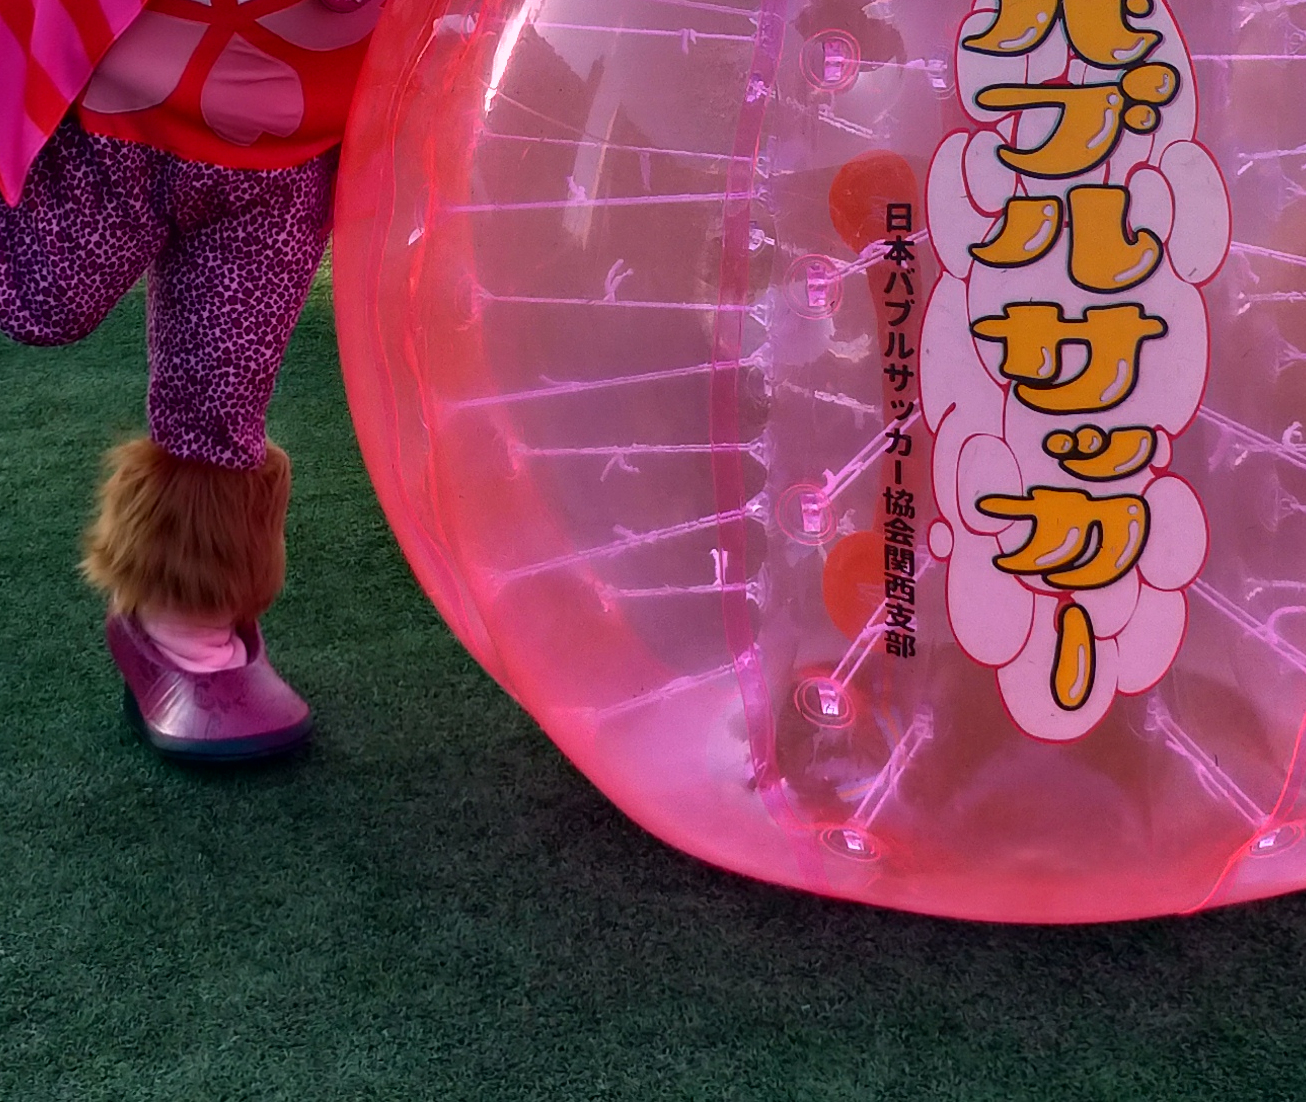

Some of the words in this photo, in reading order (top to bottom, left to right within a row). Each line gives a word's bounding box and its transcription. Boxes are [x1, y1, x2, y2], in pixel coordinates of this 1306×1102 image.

[883, 203, 916, 659] 日本バブルサッカー協会関西支部
